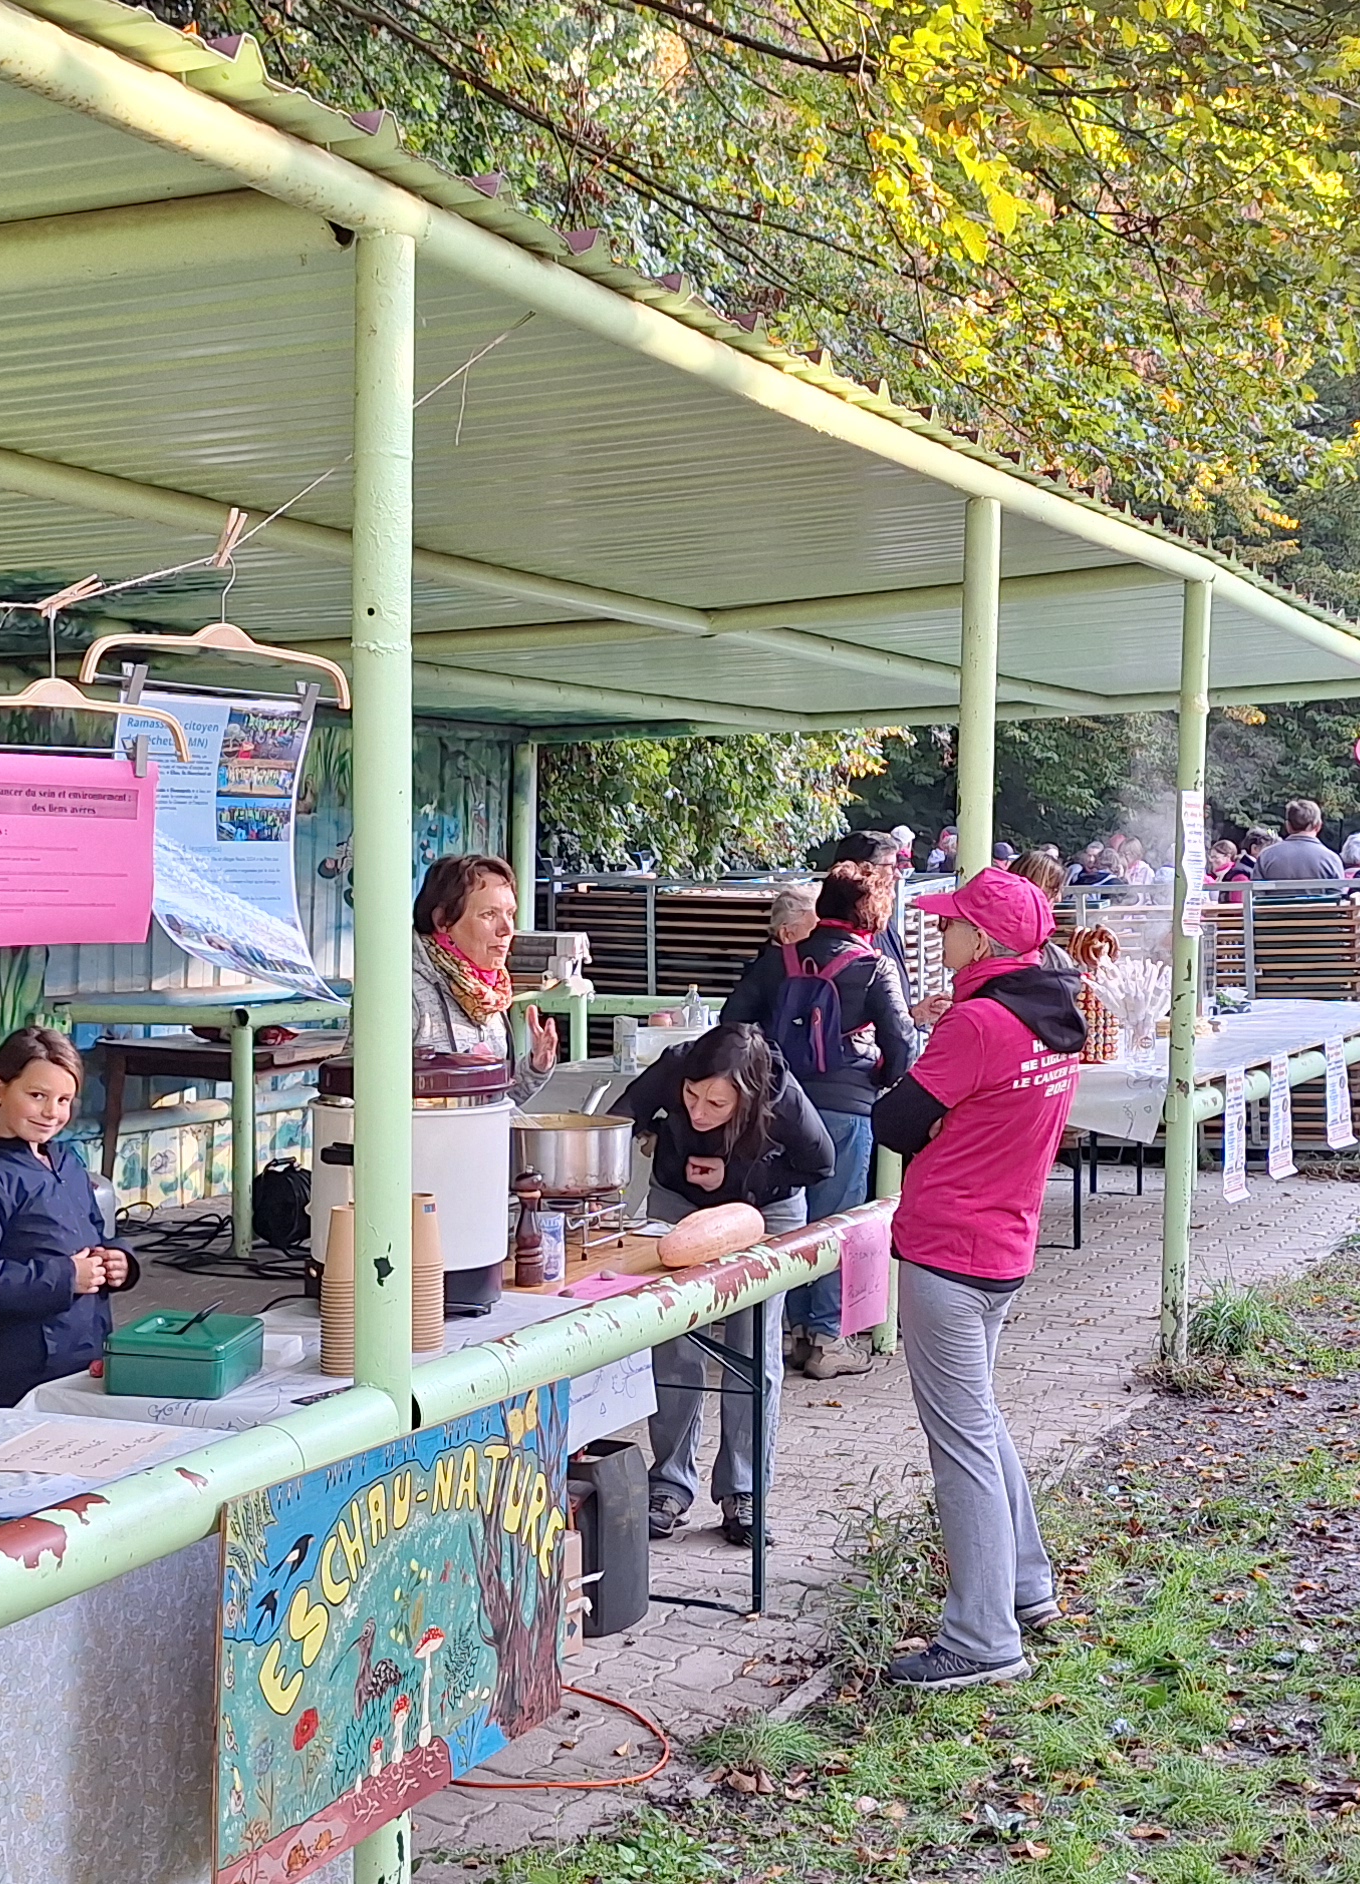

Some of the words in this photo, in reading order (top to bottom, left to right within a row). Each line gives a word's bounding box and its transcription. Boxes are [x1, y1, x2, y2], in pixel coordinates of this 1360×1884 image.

[184, 720, 219, 734] citoyen
[25, 788, 37, 798] du
[39, 788, 56, 798] sein
[32, 803, 46, 812] des
[1021, 1059, 1039, 1073] SE
[1012, 1077, 1032, 1090] LE
[1033, 1066, 1068, 1086] CANCER
[1044, 1077, 1072, 1098] 2021
[258, 1445, 565, 1716] ESCHAU-NATURE
